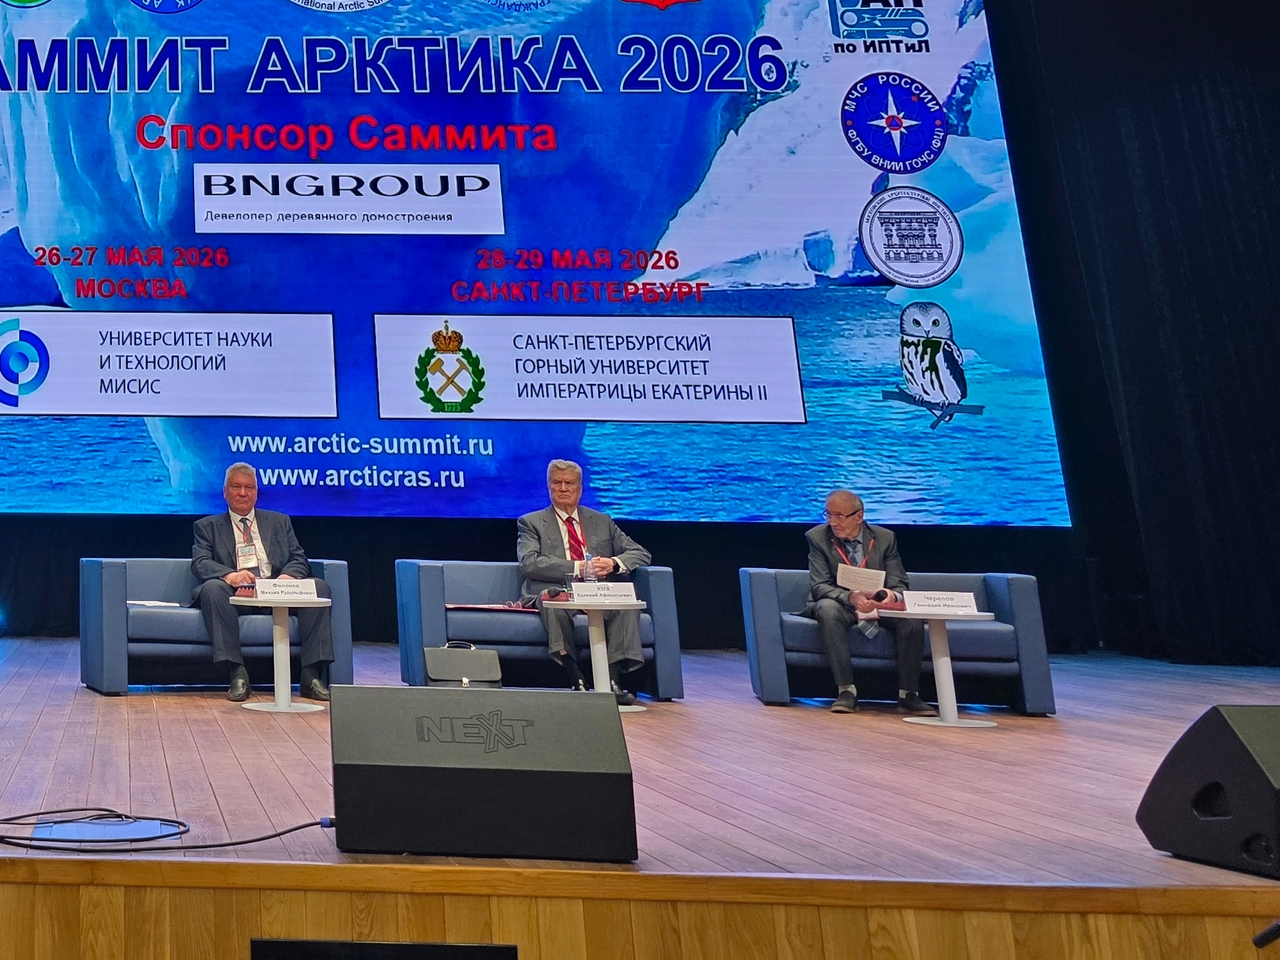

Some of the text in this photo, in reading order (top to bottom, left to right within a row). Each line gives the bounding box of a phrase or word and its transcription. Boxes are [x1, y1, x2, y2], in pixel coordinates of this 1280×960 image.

[337, 0, 365, 11] Arctic
[833, 43, 857, 54] по
[246, 35, 604, 94] АРКТИКА
[616, 33, 789, 93] 2026
[843, 74, 940, 113] МЧС РОССИИ
[136, 114, 558, 159] Спонсор Саммита
[847, 129, 872, 157] ФГБУ
[871, 154, 904, 171] ВНИИ
[905, 150, 934, 171] ГОЧС
[203, 174, 491, 197] BNGROUP
[204, 210, 454, 224] Девелопер деревянного домостроения
[33, 246, 231, 268] 26-27 МАЯ 2026
[475, 248, 681, 271] 28-29 МАЯ 2026
[75, 278, 189, 300] МОСКВА
[450, 280, 711, 304] САНКТ-ПЕТЕРБУРГ
[98, 330, 274, 348] УНИВЕРСИТЕТ НАУКИ
[512, 333, 712, 352] САНКТ-ПЕТЕРБУРГСКИЙ
[99, 353, 227, 371] И ТЕХНОЛОГИЙ
[515, 356, 710, 376] ГОРНЫЙ УНИВЕРСИТЕТ
[99, 378, 162, 395] МИСИС
[516, 381, 768, 403] ИМПЕРАТРИЦЫ ЕКАТЕРИНЫ II
[227, 432, 494, 455] www.arctic-summit.ru
[259, 465, 465, 488] www.arcticras.ru
[415, 709, 535, 754] NEXT
